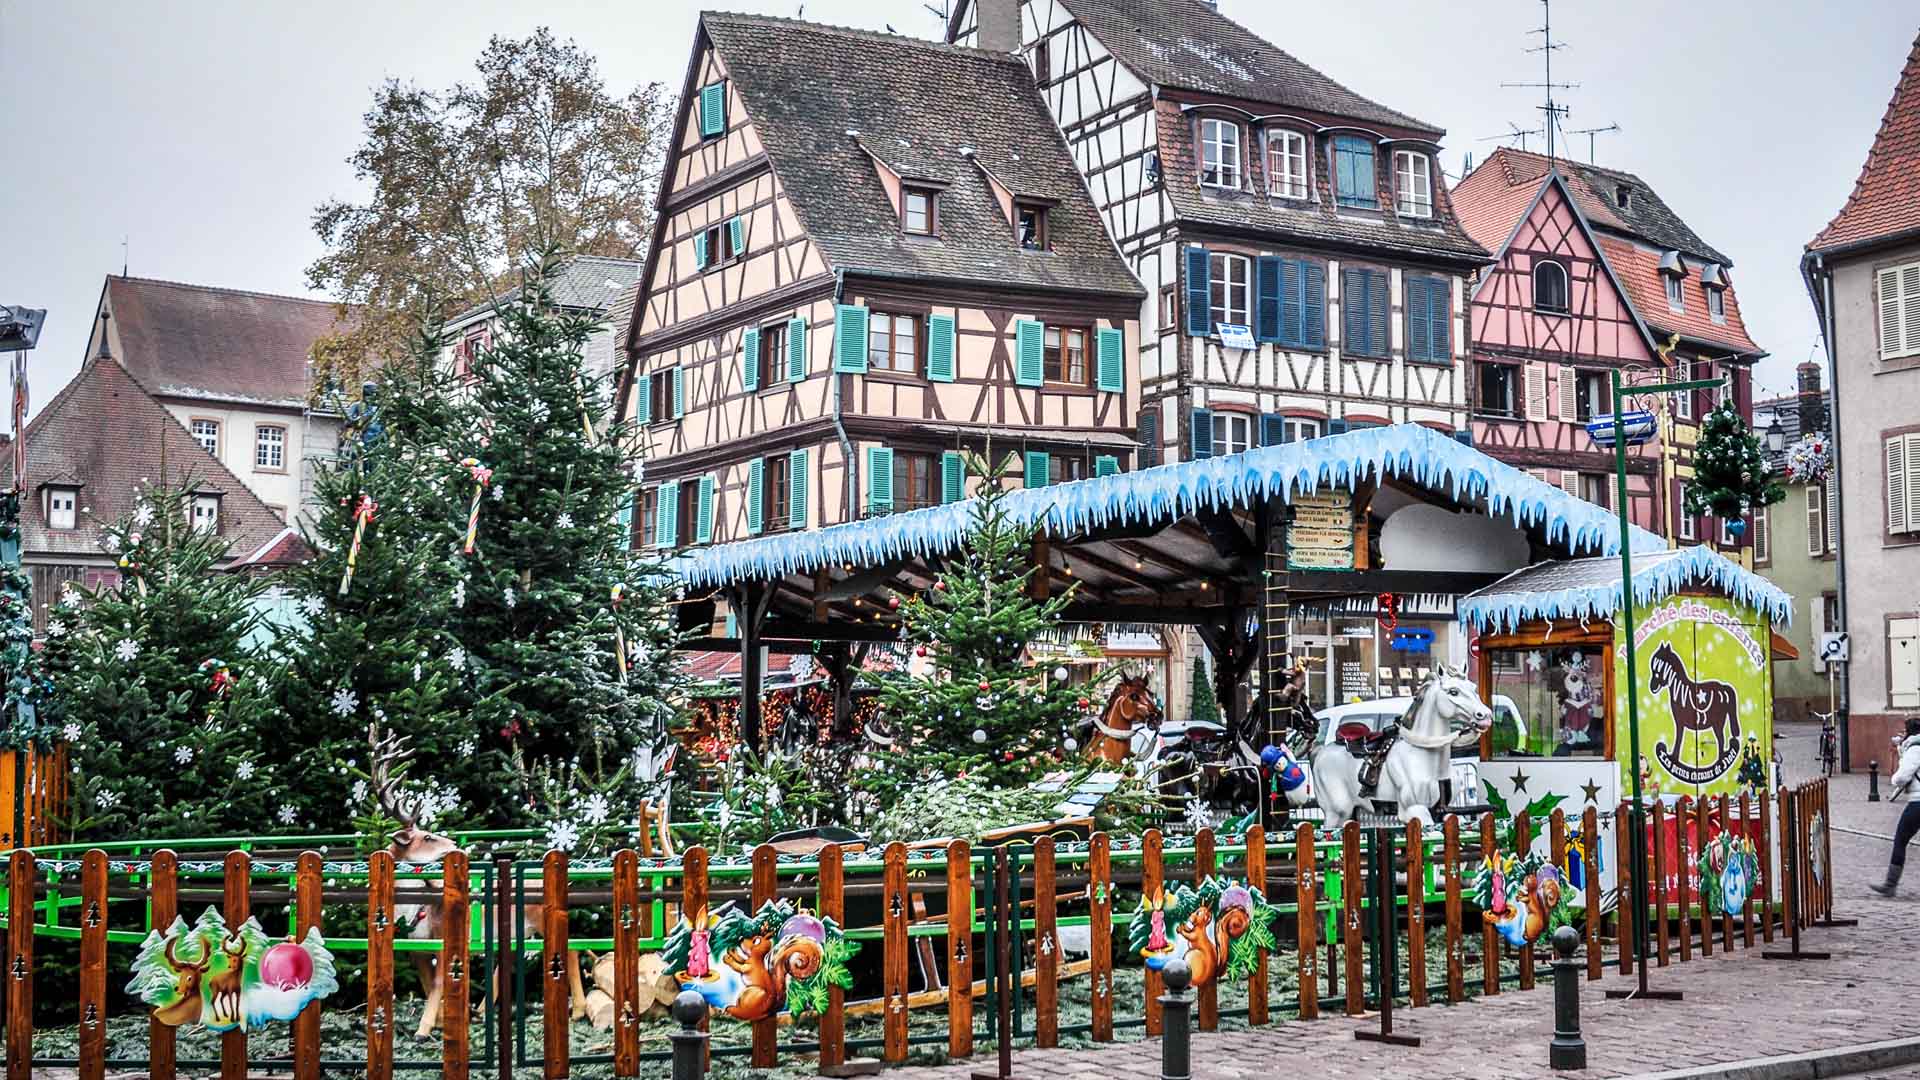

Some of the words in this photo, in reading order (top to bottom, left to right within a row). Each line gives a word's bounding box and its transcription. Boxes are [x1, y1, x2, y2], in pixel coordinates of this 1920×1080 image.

[1680, 600, 1709, 619] des
[1711, 610, 1766, 668] enfants
[1671, 764, 1690, 779] petits
[1714, 765, 1722, 775] de
